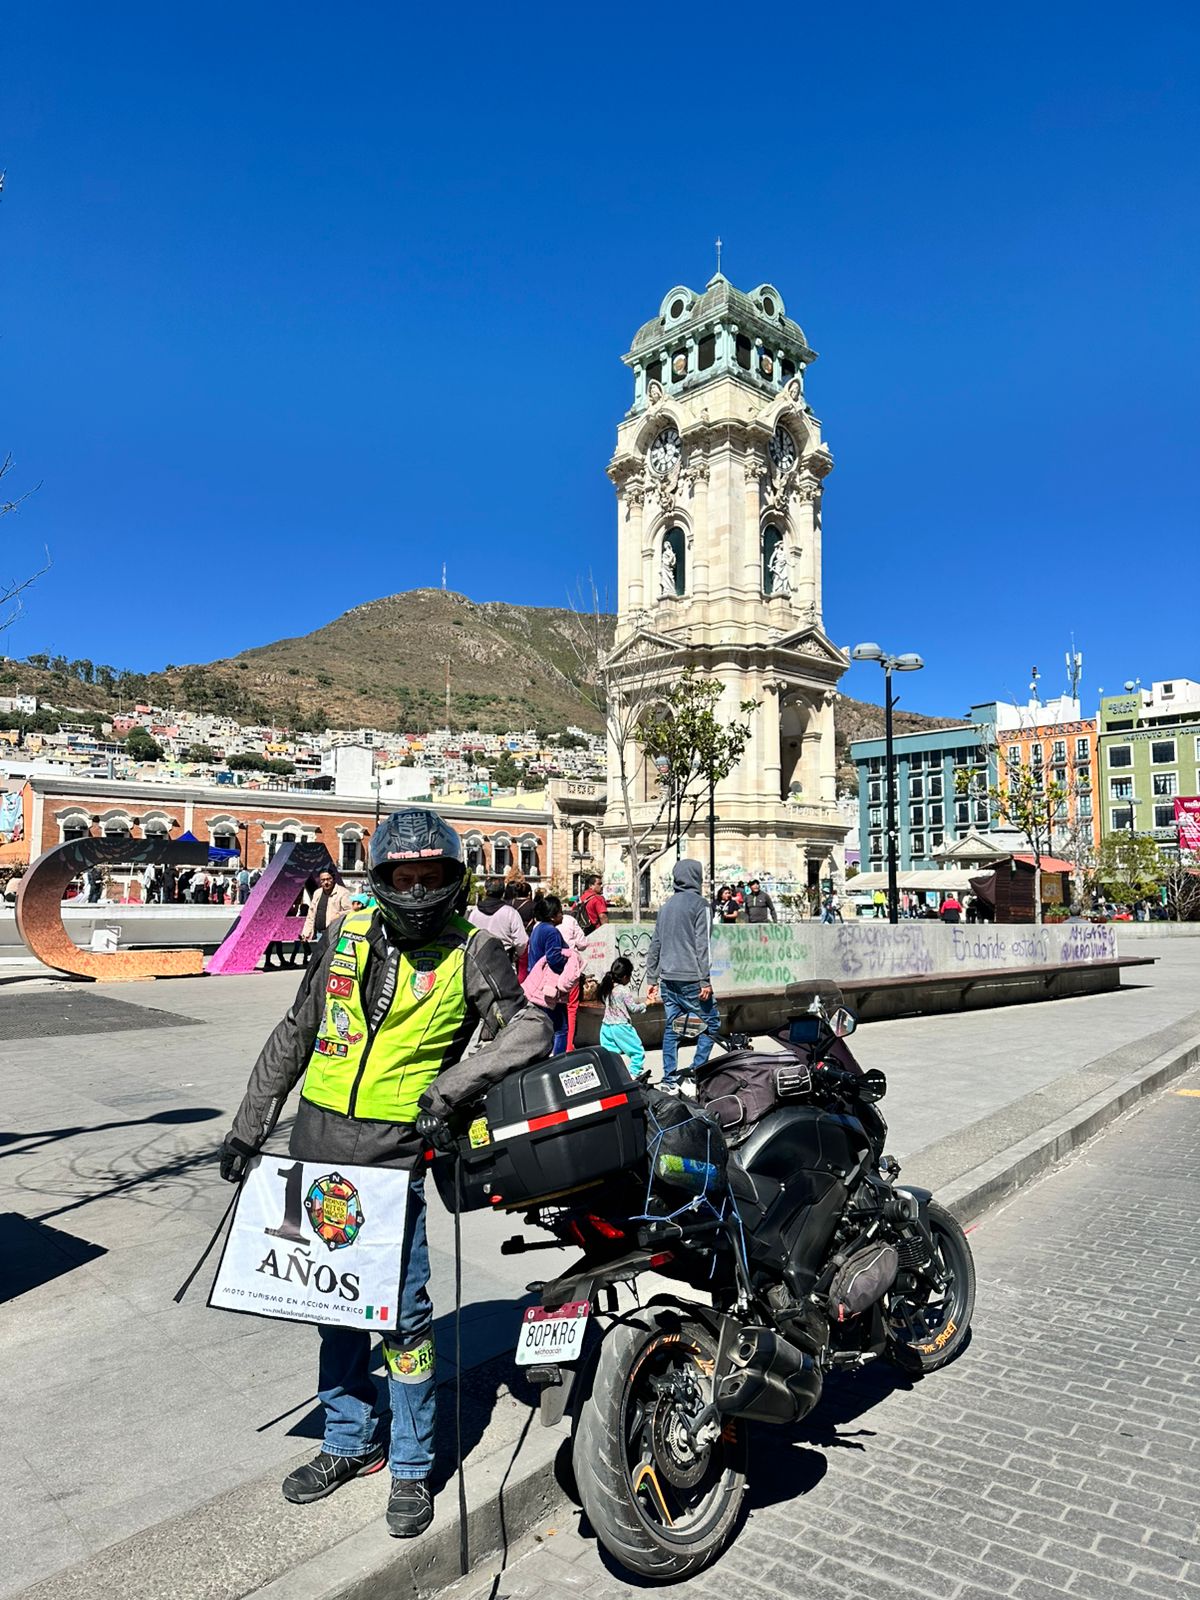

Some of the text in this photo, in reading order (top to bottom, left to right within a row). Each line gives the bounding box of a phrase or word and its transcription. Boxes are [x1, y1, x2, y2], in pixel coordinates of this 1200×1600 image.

[255, 1247, 360, 1302] AÑOS
[222, 1287, 364, 1315] MOTO TURISMO EN ACCION MEXICO
[526, 1321, 578, 1348] 80PKR6
[935, 1320, 958, 1350] STREET
